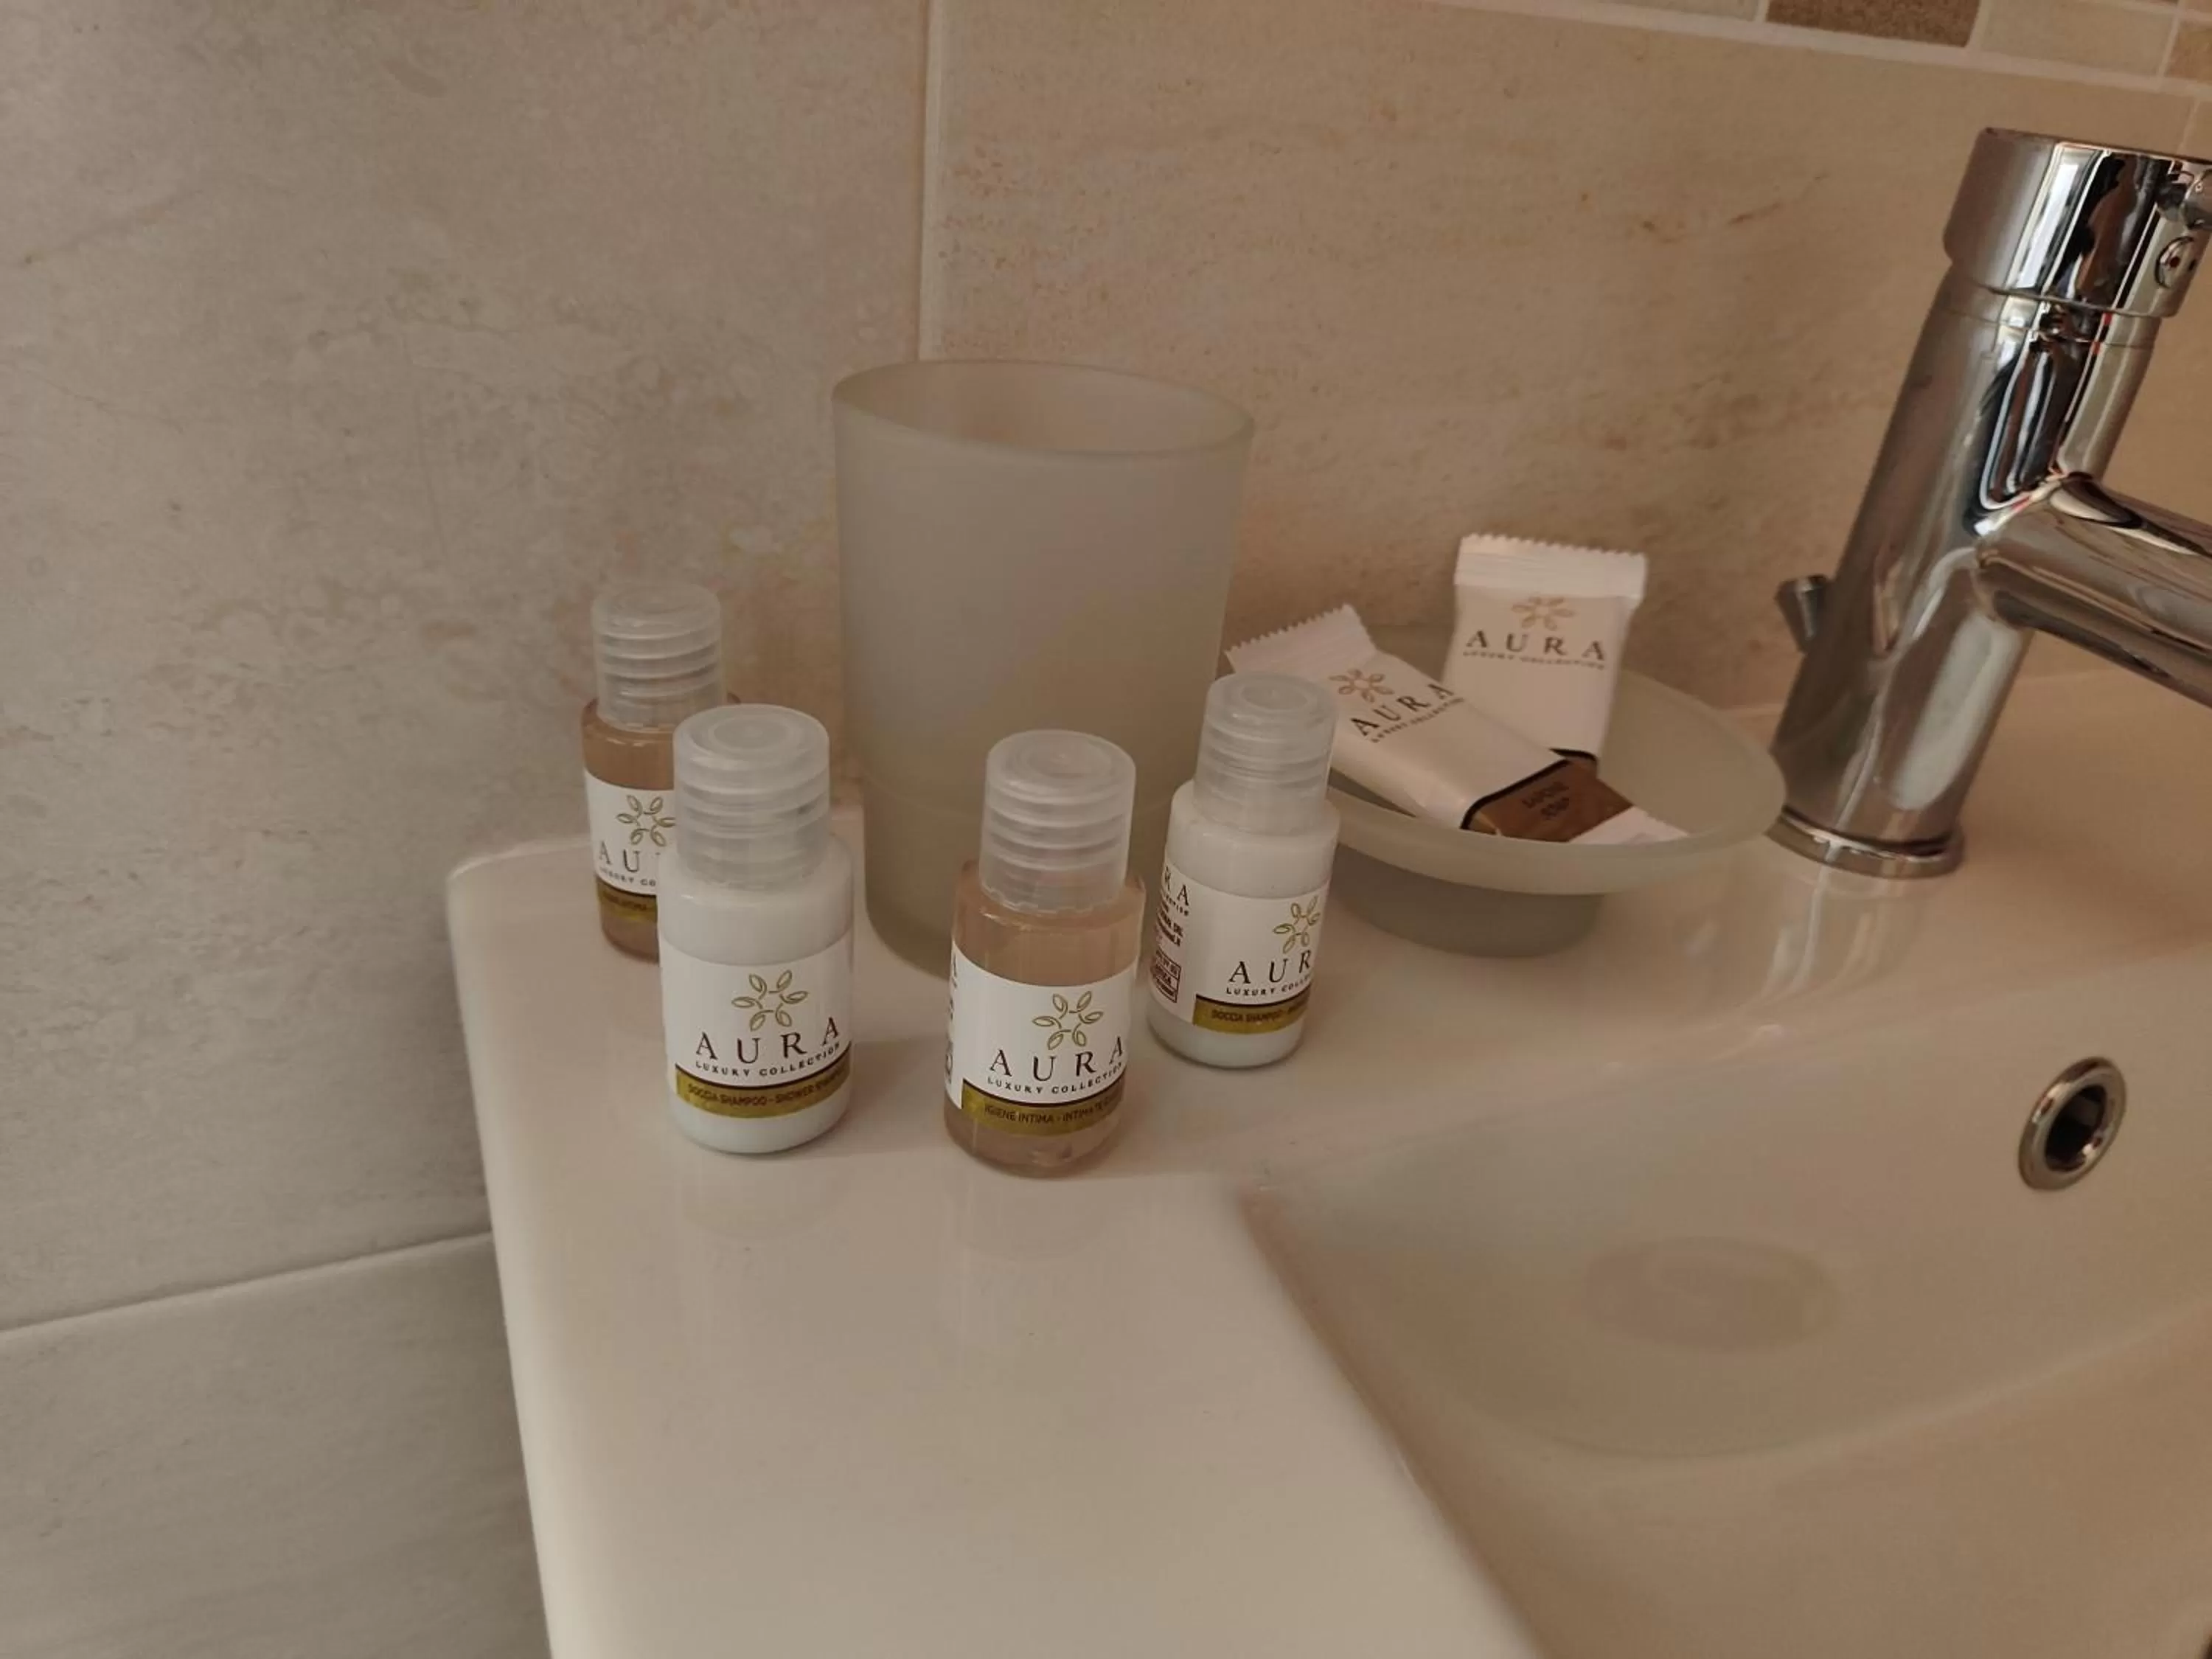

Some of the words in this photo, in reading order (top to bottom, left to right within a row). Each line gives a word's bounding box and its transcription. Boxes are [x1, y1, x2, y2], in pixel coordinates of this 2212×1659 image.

[1466, 630, 1605, 661] AURA
[1351, 684, 1455, 737] AURA
[599, 841, 661, 873] AU
[1228, 949, 1311, 984] AUR
[1226, 987, 1275, 996] LUXURY
[695, 1017, 840, 1064] AURA
[695, 1060, 750, 1077] LUXURY
[989, 1035, 1123, 1082] AURA
[987, 1076, 1043, 1094] LUXURY
